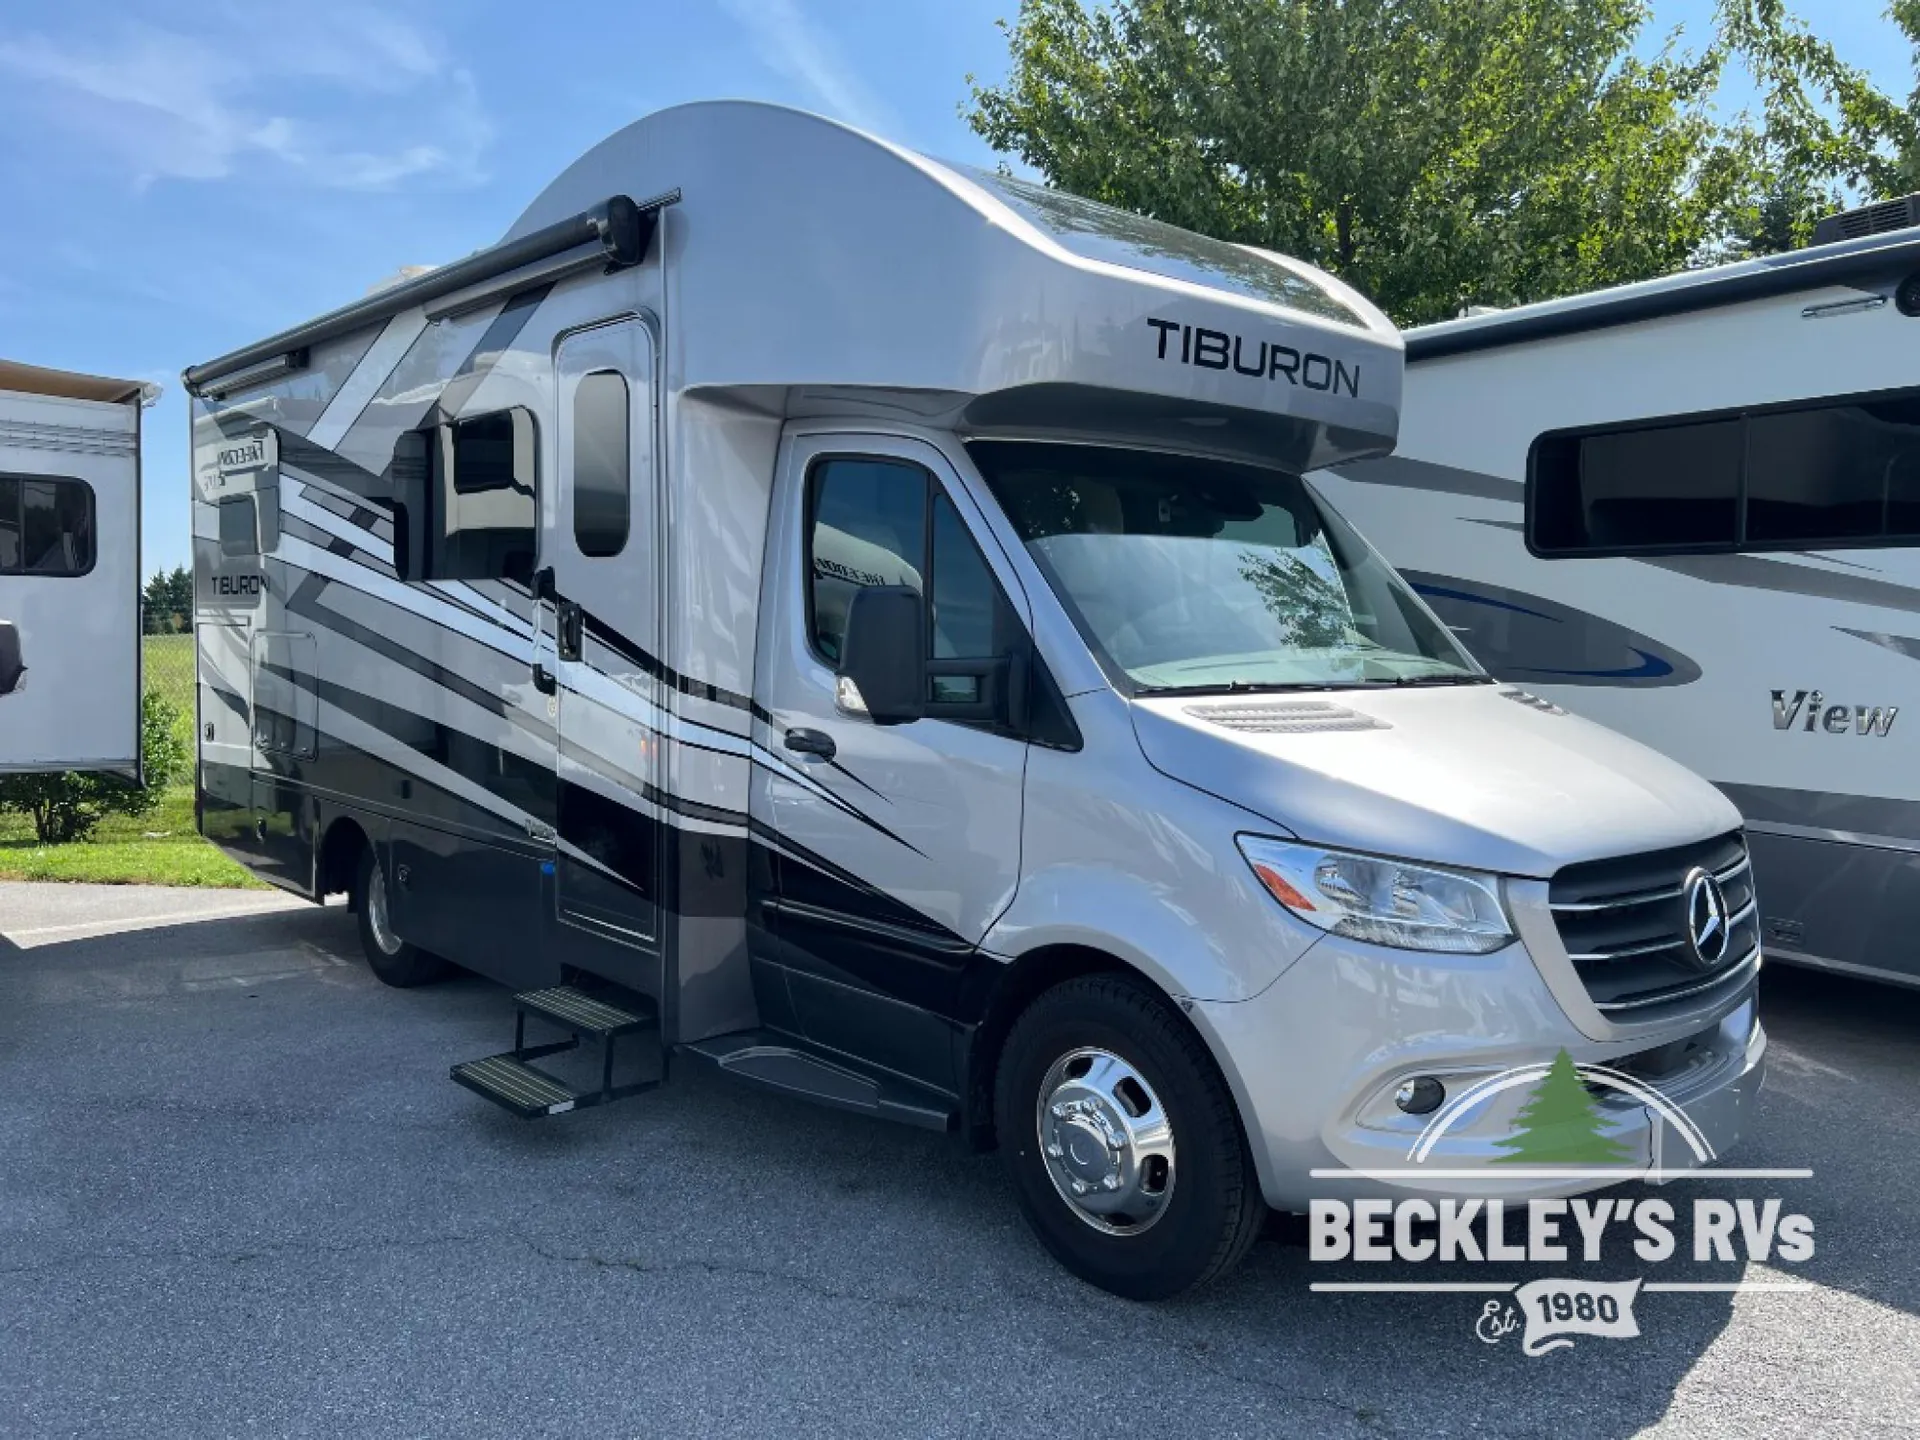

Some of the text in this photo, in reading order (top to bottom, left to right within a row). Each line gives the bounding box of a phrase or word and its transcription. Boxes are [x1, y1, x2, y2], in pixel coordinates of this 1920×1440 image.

[1147, 317, 1361, 398] TIBURON
[211, 575, 271, 596] TIBURON
[1769, 689, 1899, 738] View
